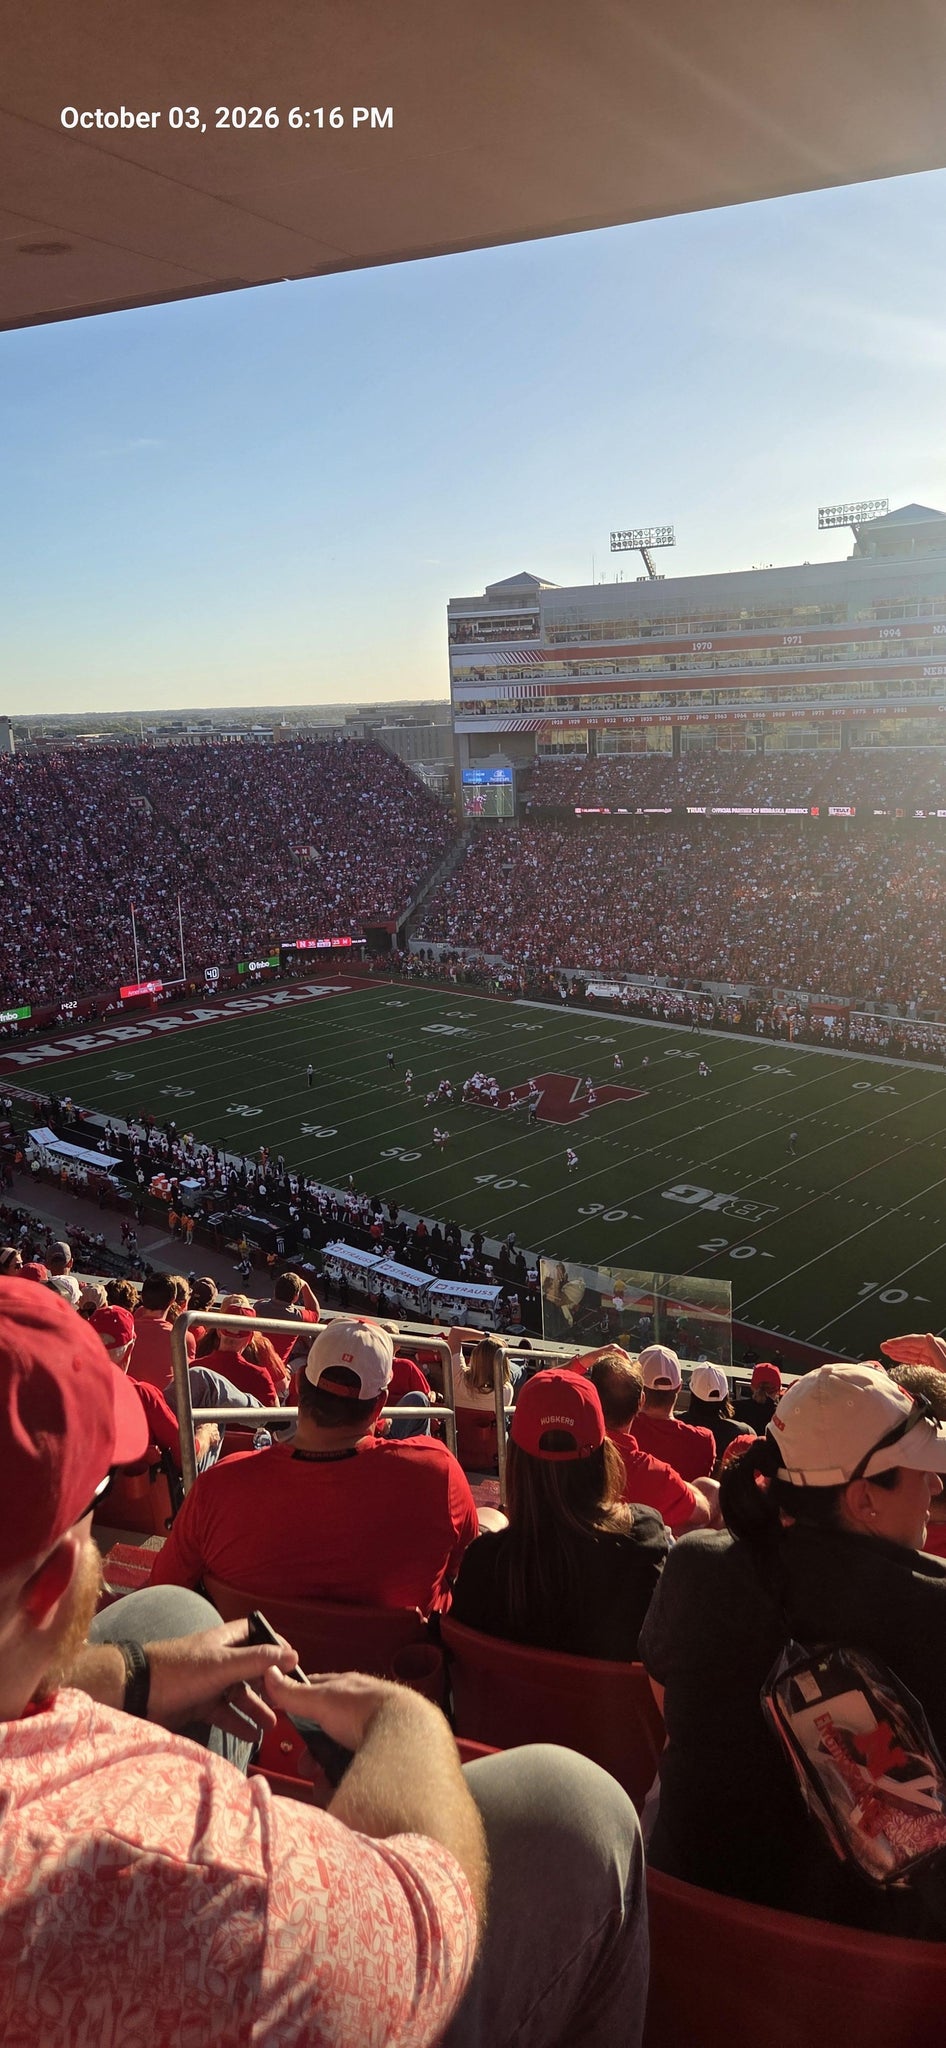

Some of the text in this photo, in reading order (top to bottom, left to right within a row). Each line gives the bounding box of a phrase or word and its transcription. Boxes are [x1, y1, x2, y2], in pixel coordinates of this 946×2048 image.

[692, 642, 712, 650] 1970
[784, 636, 802, 644] 1971
[879, 628, 900, 638] 1994
[206, 969, 217, 978] 40
[4, 985, 352, 1065] NEBRASKA
[226, 1104, 264, 1117] 30
[301, 1124, 338, 1138] 40
[380, 1147, 422, 1162] 50
[473, 1174, 519, 1190] 40
[578, 1203, 629, 1222] 30
[698, 1238, 757, 1259] 20
[857, 1282, 908, 1304] 10
[390, 1268, 425, 1283] STRAUSS
[449, 1286, 494, 1296] STRAUSS
[540, 1416, 575, 1426] HUSKERS
